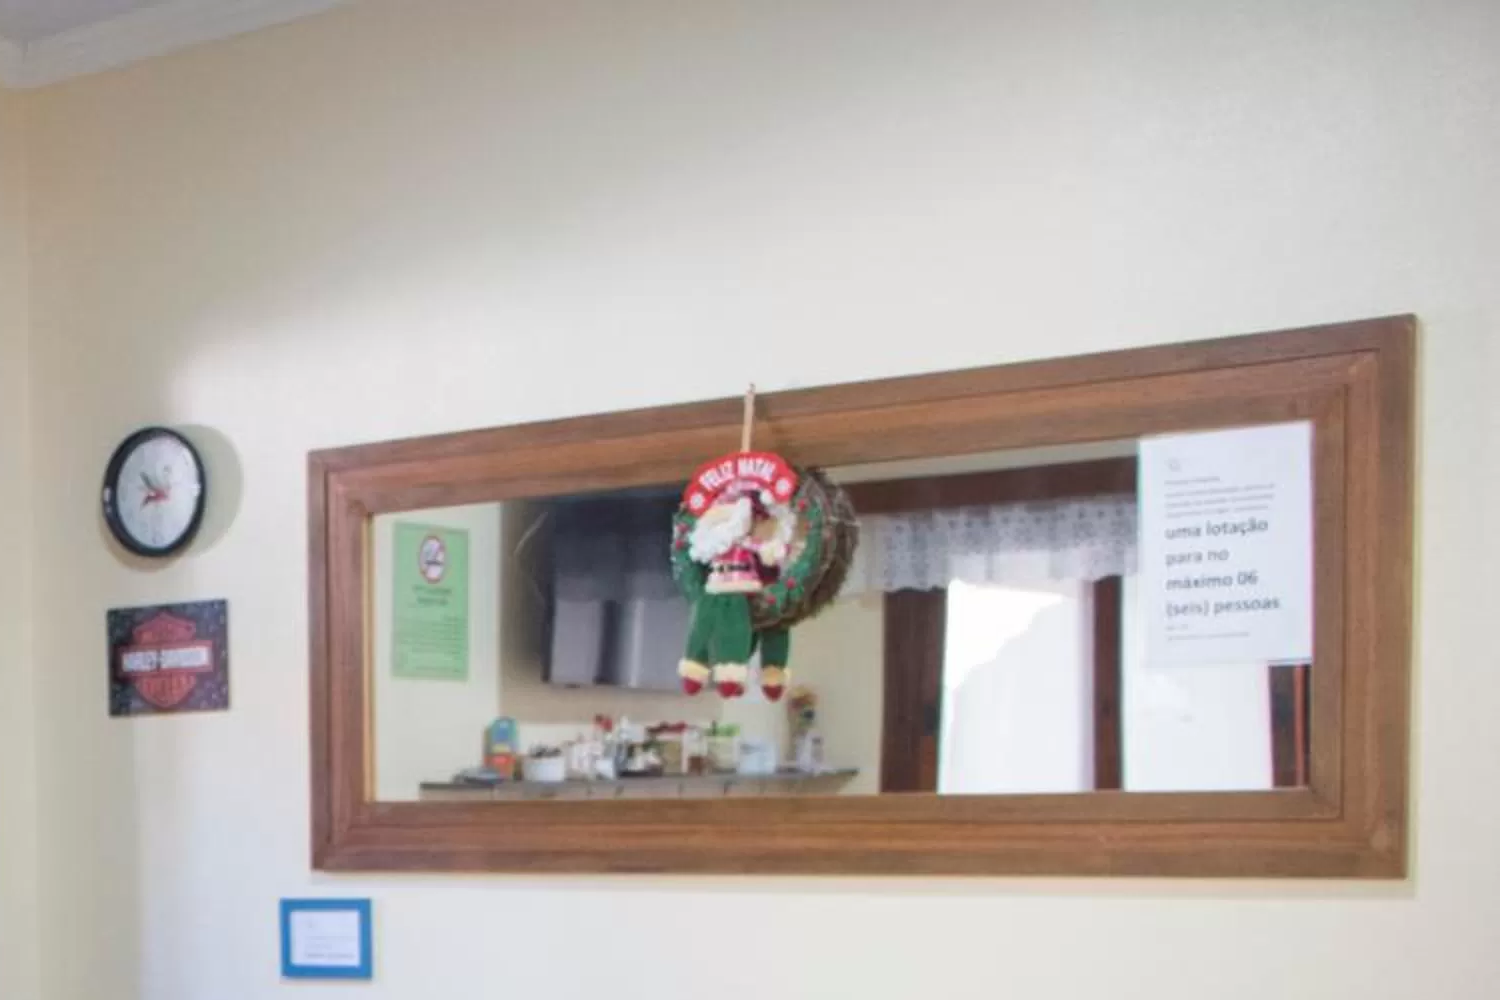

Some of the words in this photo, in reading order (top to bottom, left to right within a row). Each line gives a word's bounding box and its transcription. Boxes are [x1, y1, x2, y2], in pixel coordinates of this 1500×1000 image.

[1163, 526, 1202, 540] uma
[1206, 517, 1269, 537] lotação
[1164, 551, 1203, 567] para
[1207, 548, 1230, 561] no
[1165, 574, 1233, 591] máximo
[1236, 569, 1259, 586] 06
[1165, 600, 1210, 617] (seis)
[1213, 597, 1281, 617] pessoas
